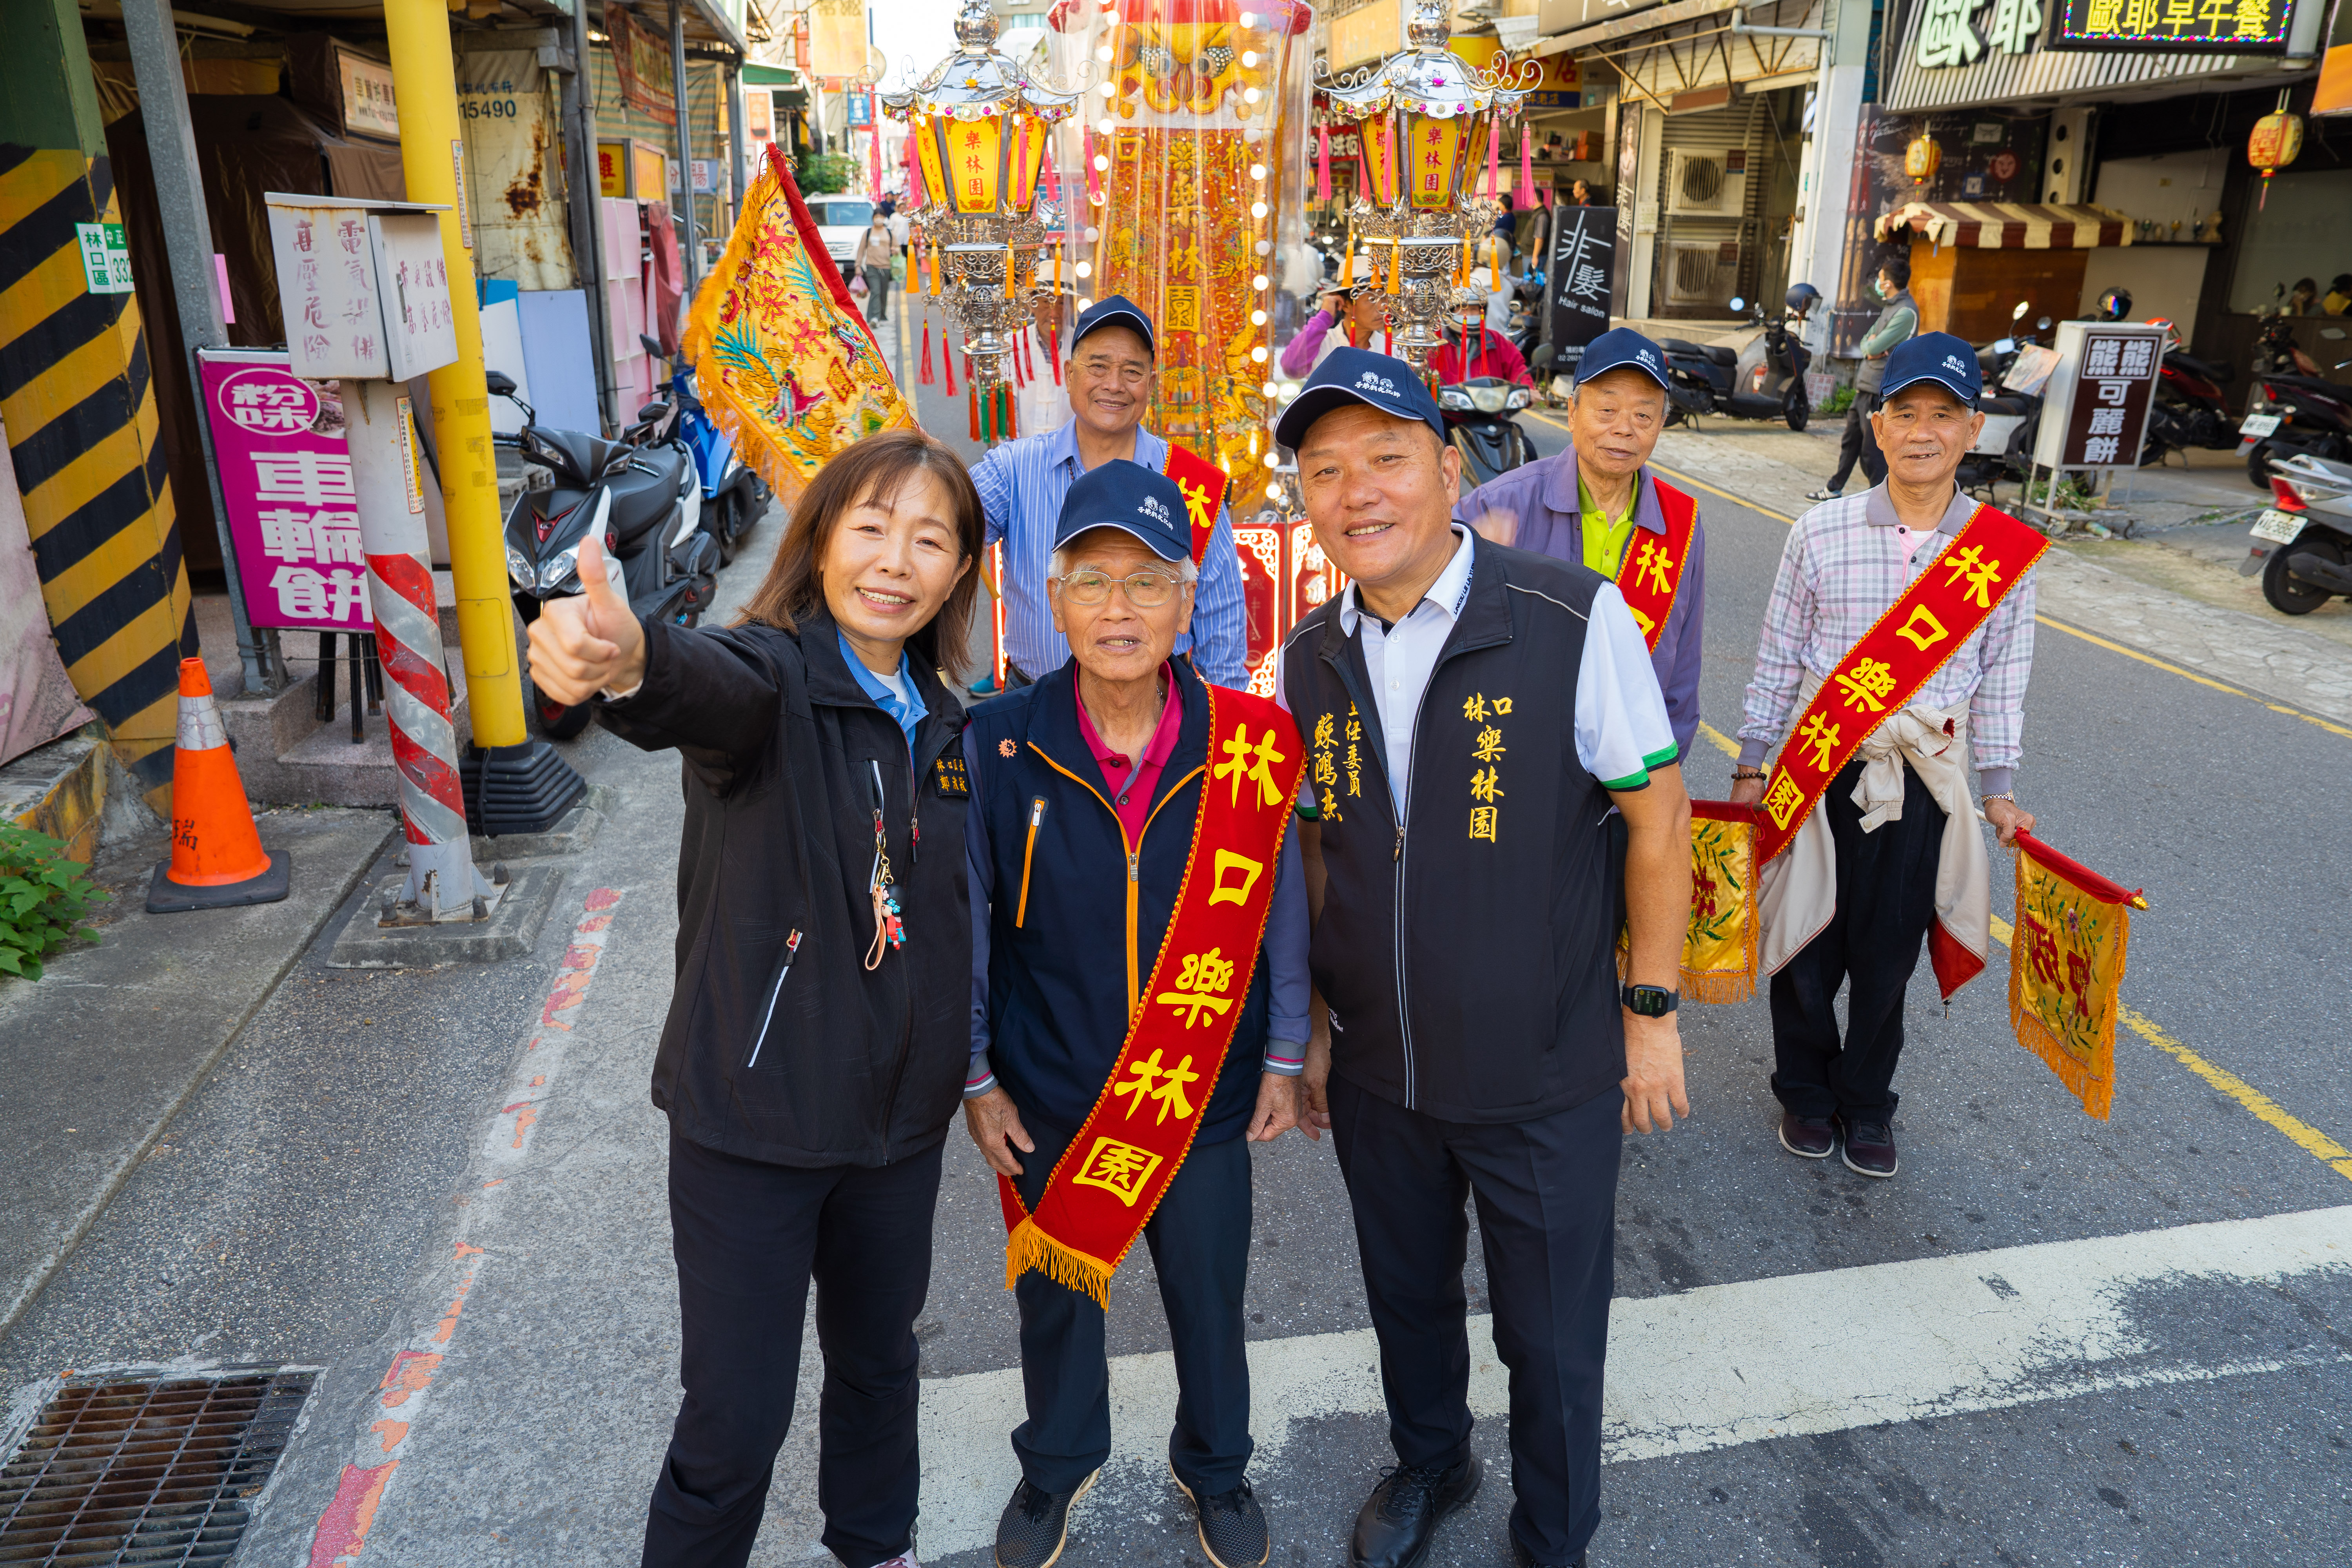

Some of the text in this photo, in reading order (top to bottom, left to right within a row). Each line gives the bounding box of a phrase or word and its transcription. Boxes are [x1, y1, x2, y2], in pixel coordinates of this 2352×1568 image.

[2085, 0, 2271, 37] 歐耶早午餐
[458, 100, 517, 120] 15490
[965, 130, 984, 197] 樂林園
[1223, 136, 1258, 171] 林
[1425, 126, 1443, 192] 樂林園
[85, 231, 111, 285] 林口區
[106, 229, 124, 244] 中正
[1166, 172, 1209, 332] 樂林園
[1557, 210, 1612, 301] 非髮
[1558, 295, 1606, 318] Hair salon
[2087, 339, 2151, 376] 熊熊
[231, 383, 314, 431] 粉味
[2083, 379, 2132, 464] 可麗餅
[249, 450, 373, 622] 車輪餅
[1463, 692, 1513, 722] 林口
[1766, 544, 2002, 831] 林口樂林園
[936, 759, 965, 772] 林口區長
[1343, 700, 1363, 798] 主任委員
[1469, 724, 1506, 843] 樂林園
[1073, 722, 1285, 1207] 林口樂林園
